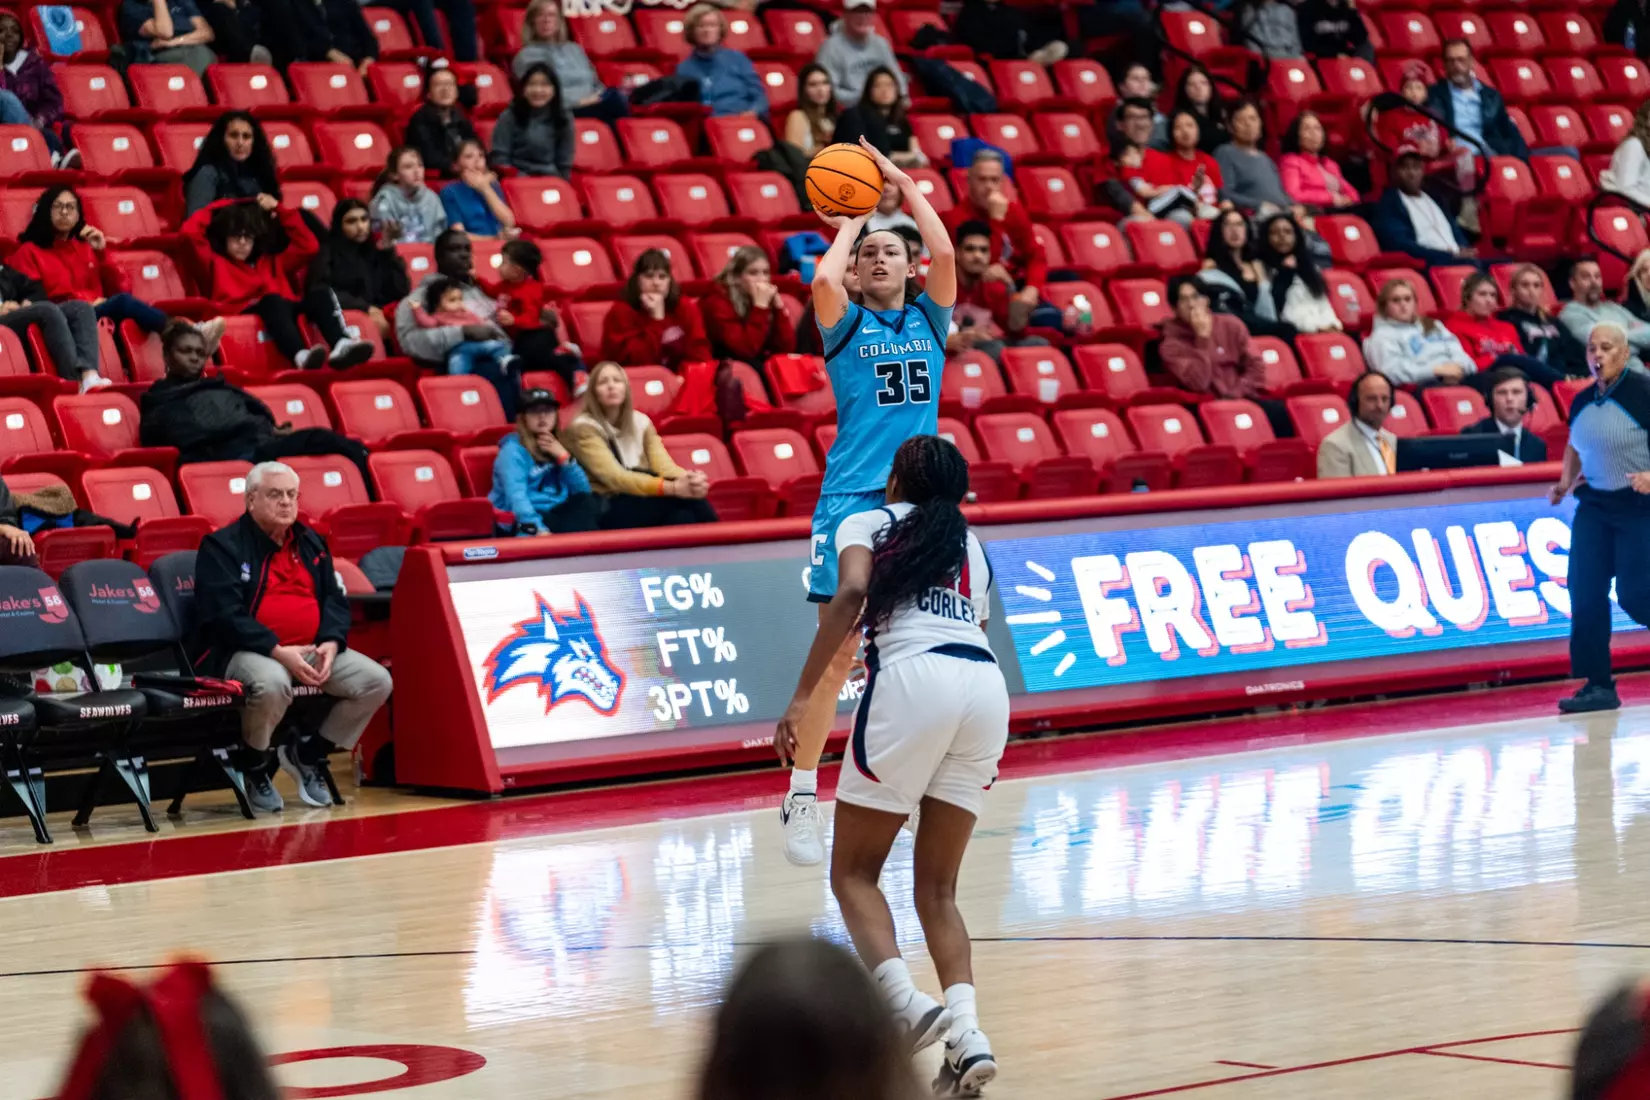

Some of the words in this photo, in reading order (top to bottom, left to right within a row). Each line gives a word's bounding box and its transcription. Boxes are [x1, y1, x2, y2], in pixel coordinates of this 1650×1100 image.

[859, 339, 932, 358] COLUMBIA
[874, 359, 931, 407] 35
[89, 583, 136, 598] Jake's
[138, 586, 154, 598] 58
[640, 573, 724, 613] FG%
[1071, 539, 1329, 665] FREE
[1345, 516, 1573, 635] QUES
[0, 595, 42, 611] ake's
[44, 595, 62, 607] 58
[656, 626, 738, 668] FT%
[648, 678, 750, 722] 3PT%
[80, 704, 132, 719] SEAWOLVES
